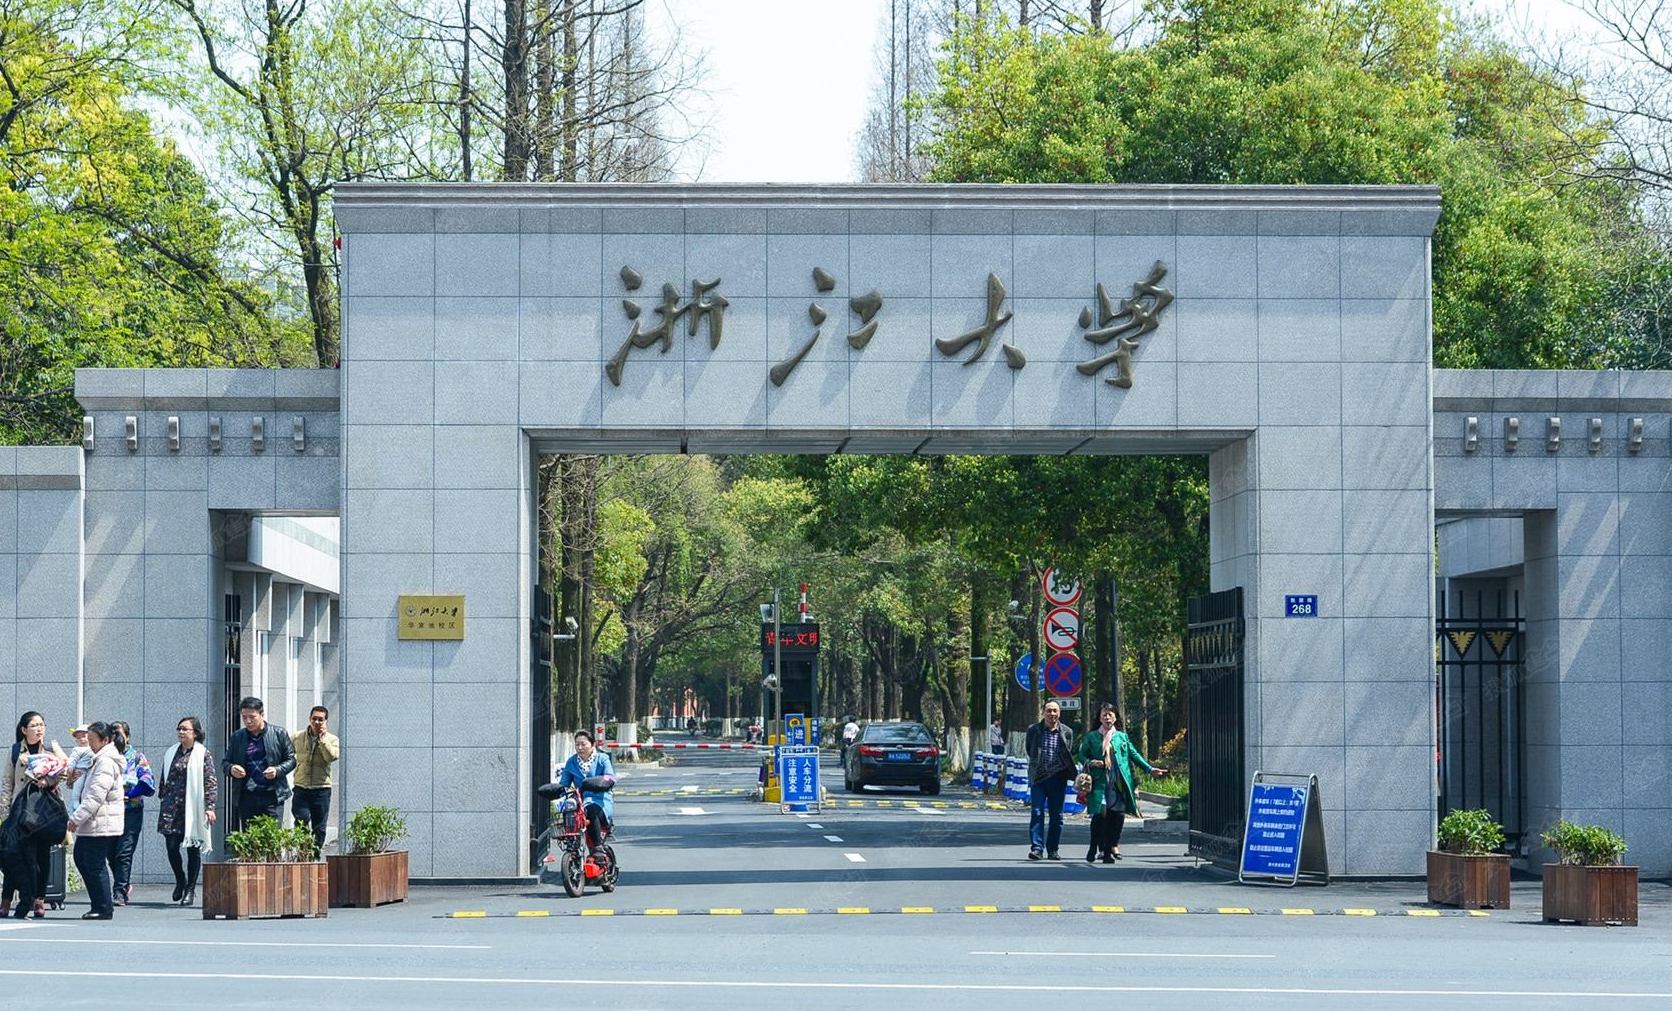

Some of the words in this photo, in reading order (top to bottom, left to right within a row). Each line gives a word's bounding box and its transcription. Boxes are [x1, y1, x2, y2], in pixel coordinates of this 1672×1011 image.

[605, 259, 1175, 389] 浙江大学
[1292, 604, 1311, 614] 268
[788, 758, 798, 793] 注意安全
[803, 758, 813, 793] 人车分流
